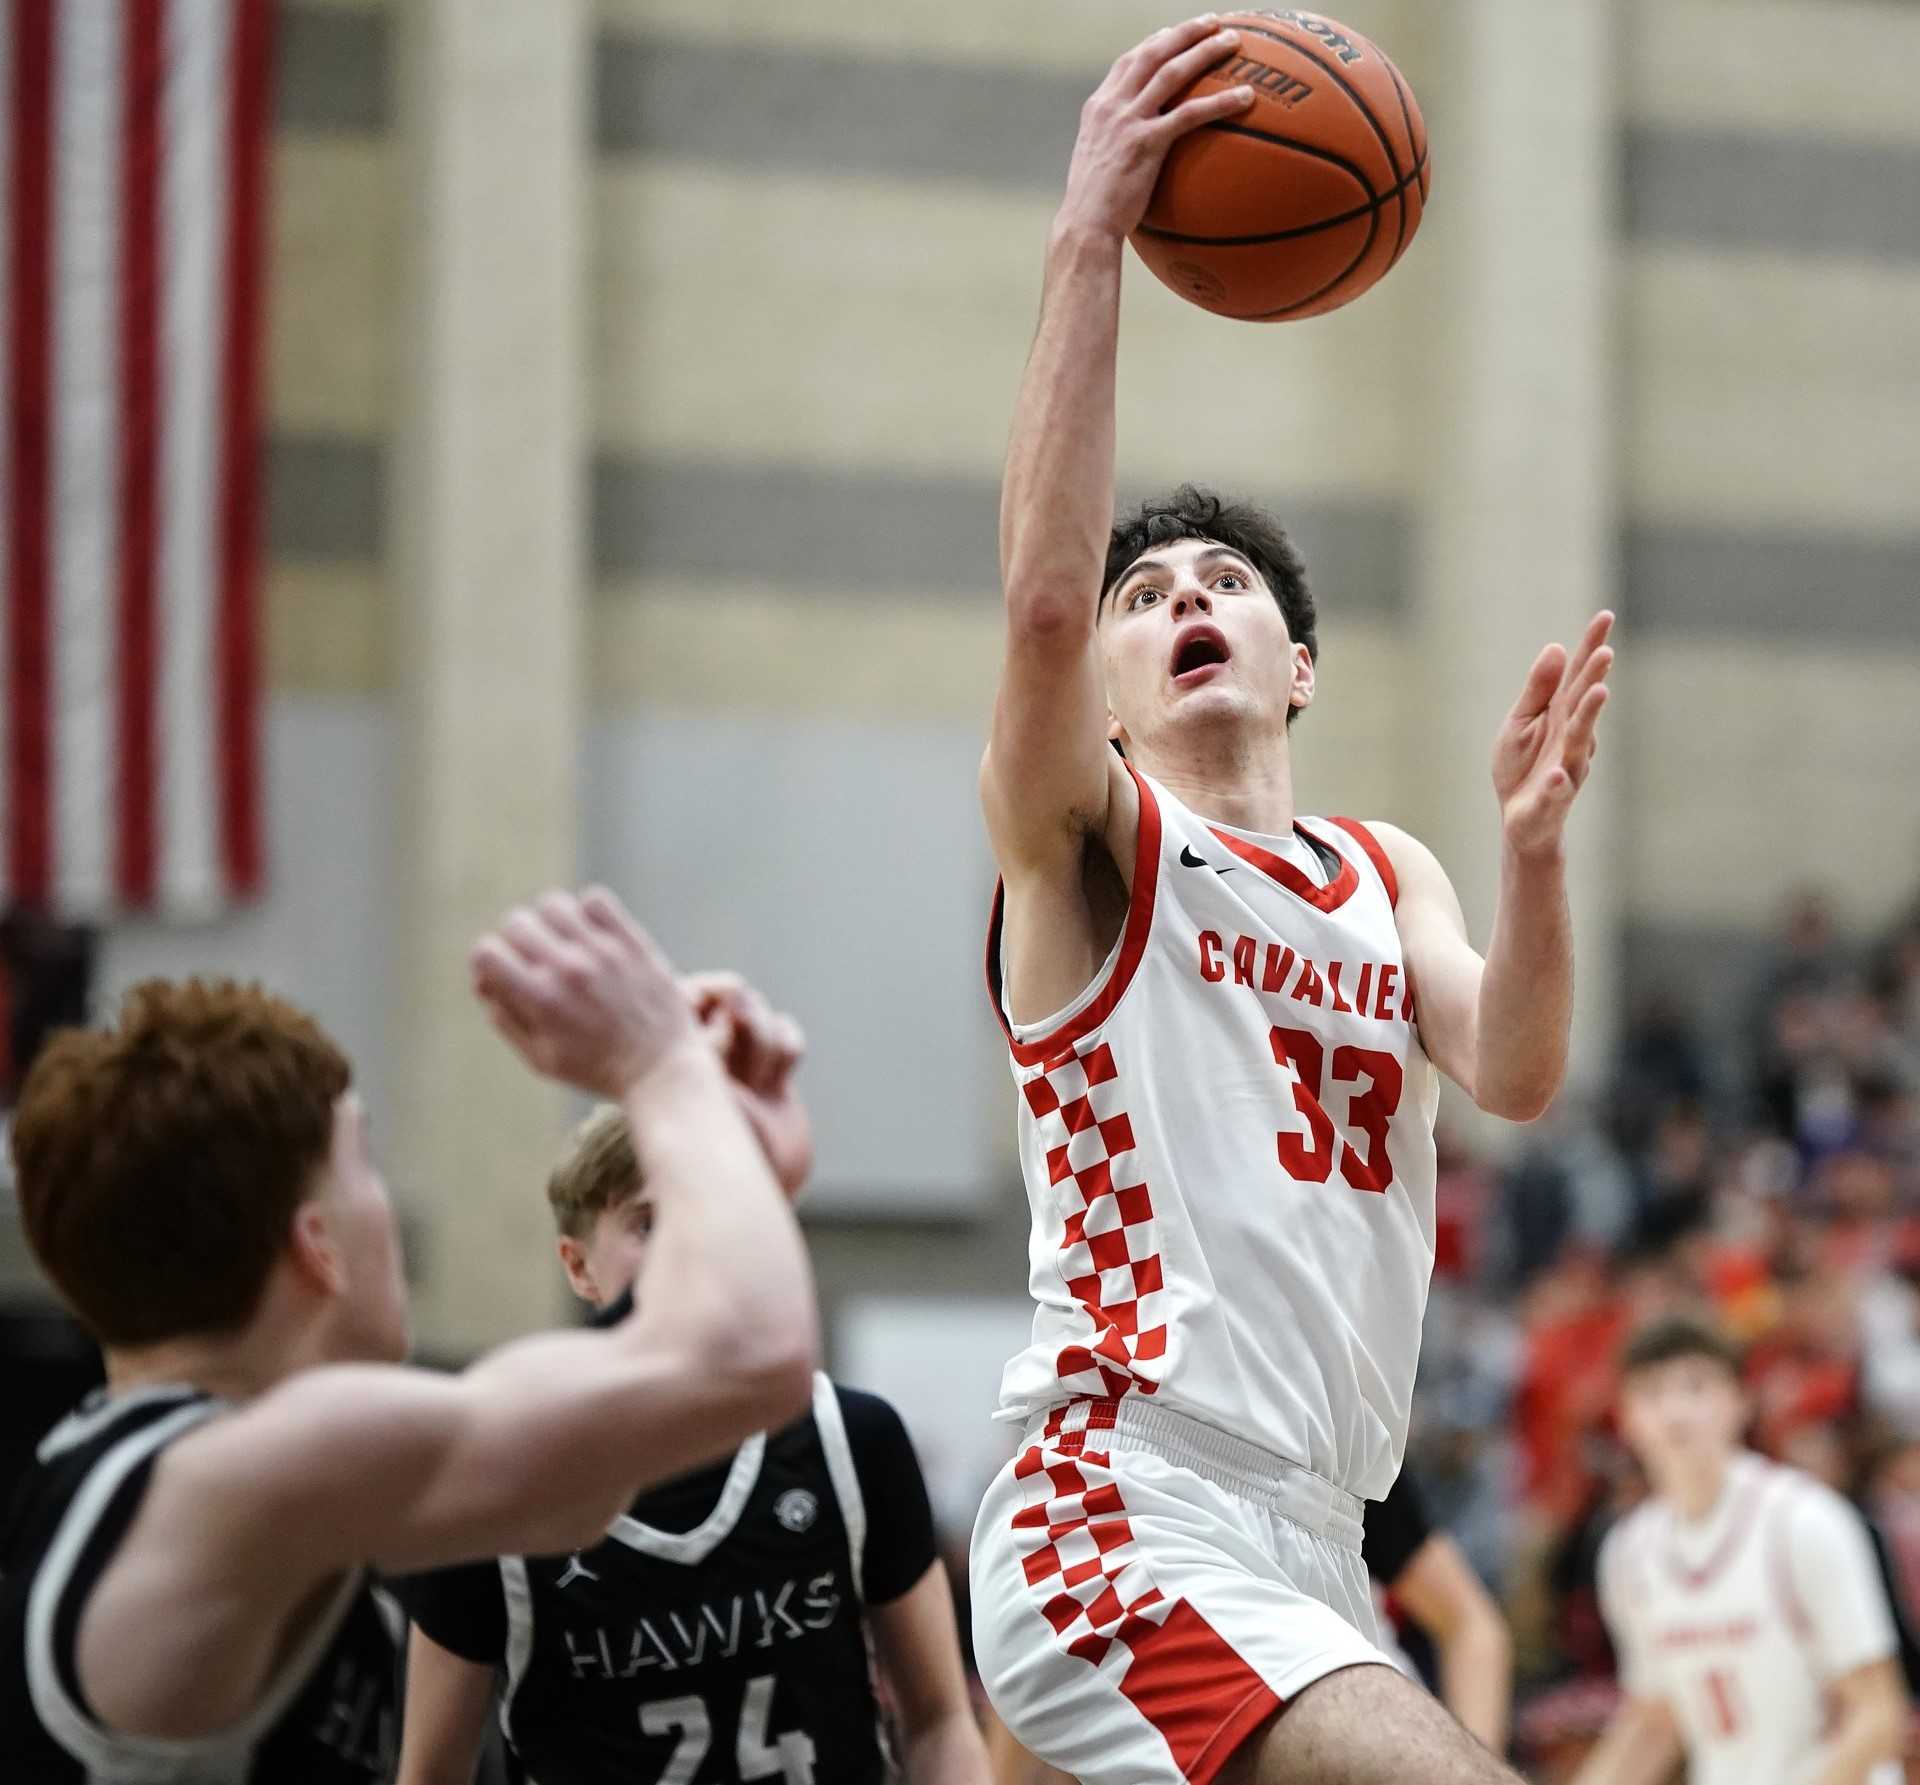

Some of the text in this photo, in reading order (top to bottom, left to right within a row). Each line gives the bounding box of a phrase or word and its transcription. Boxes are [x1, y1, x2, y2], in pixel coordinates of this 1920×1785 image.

[1269, 1024, 1403, 1194] 33
[564, 1571, 841, 1679] HAWKS
[638, 1674, 817, 1785] 24
